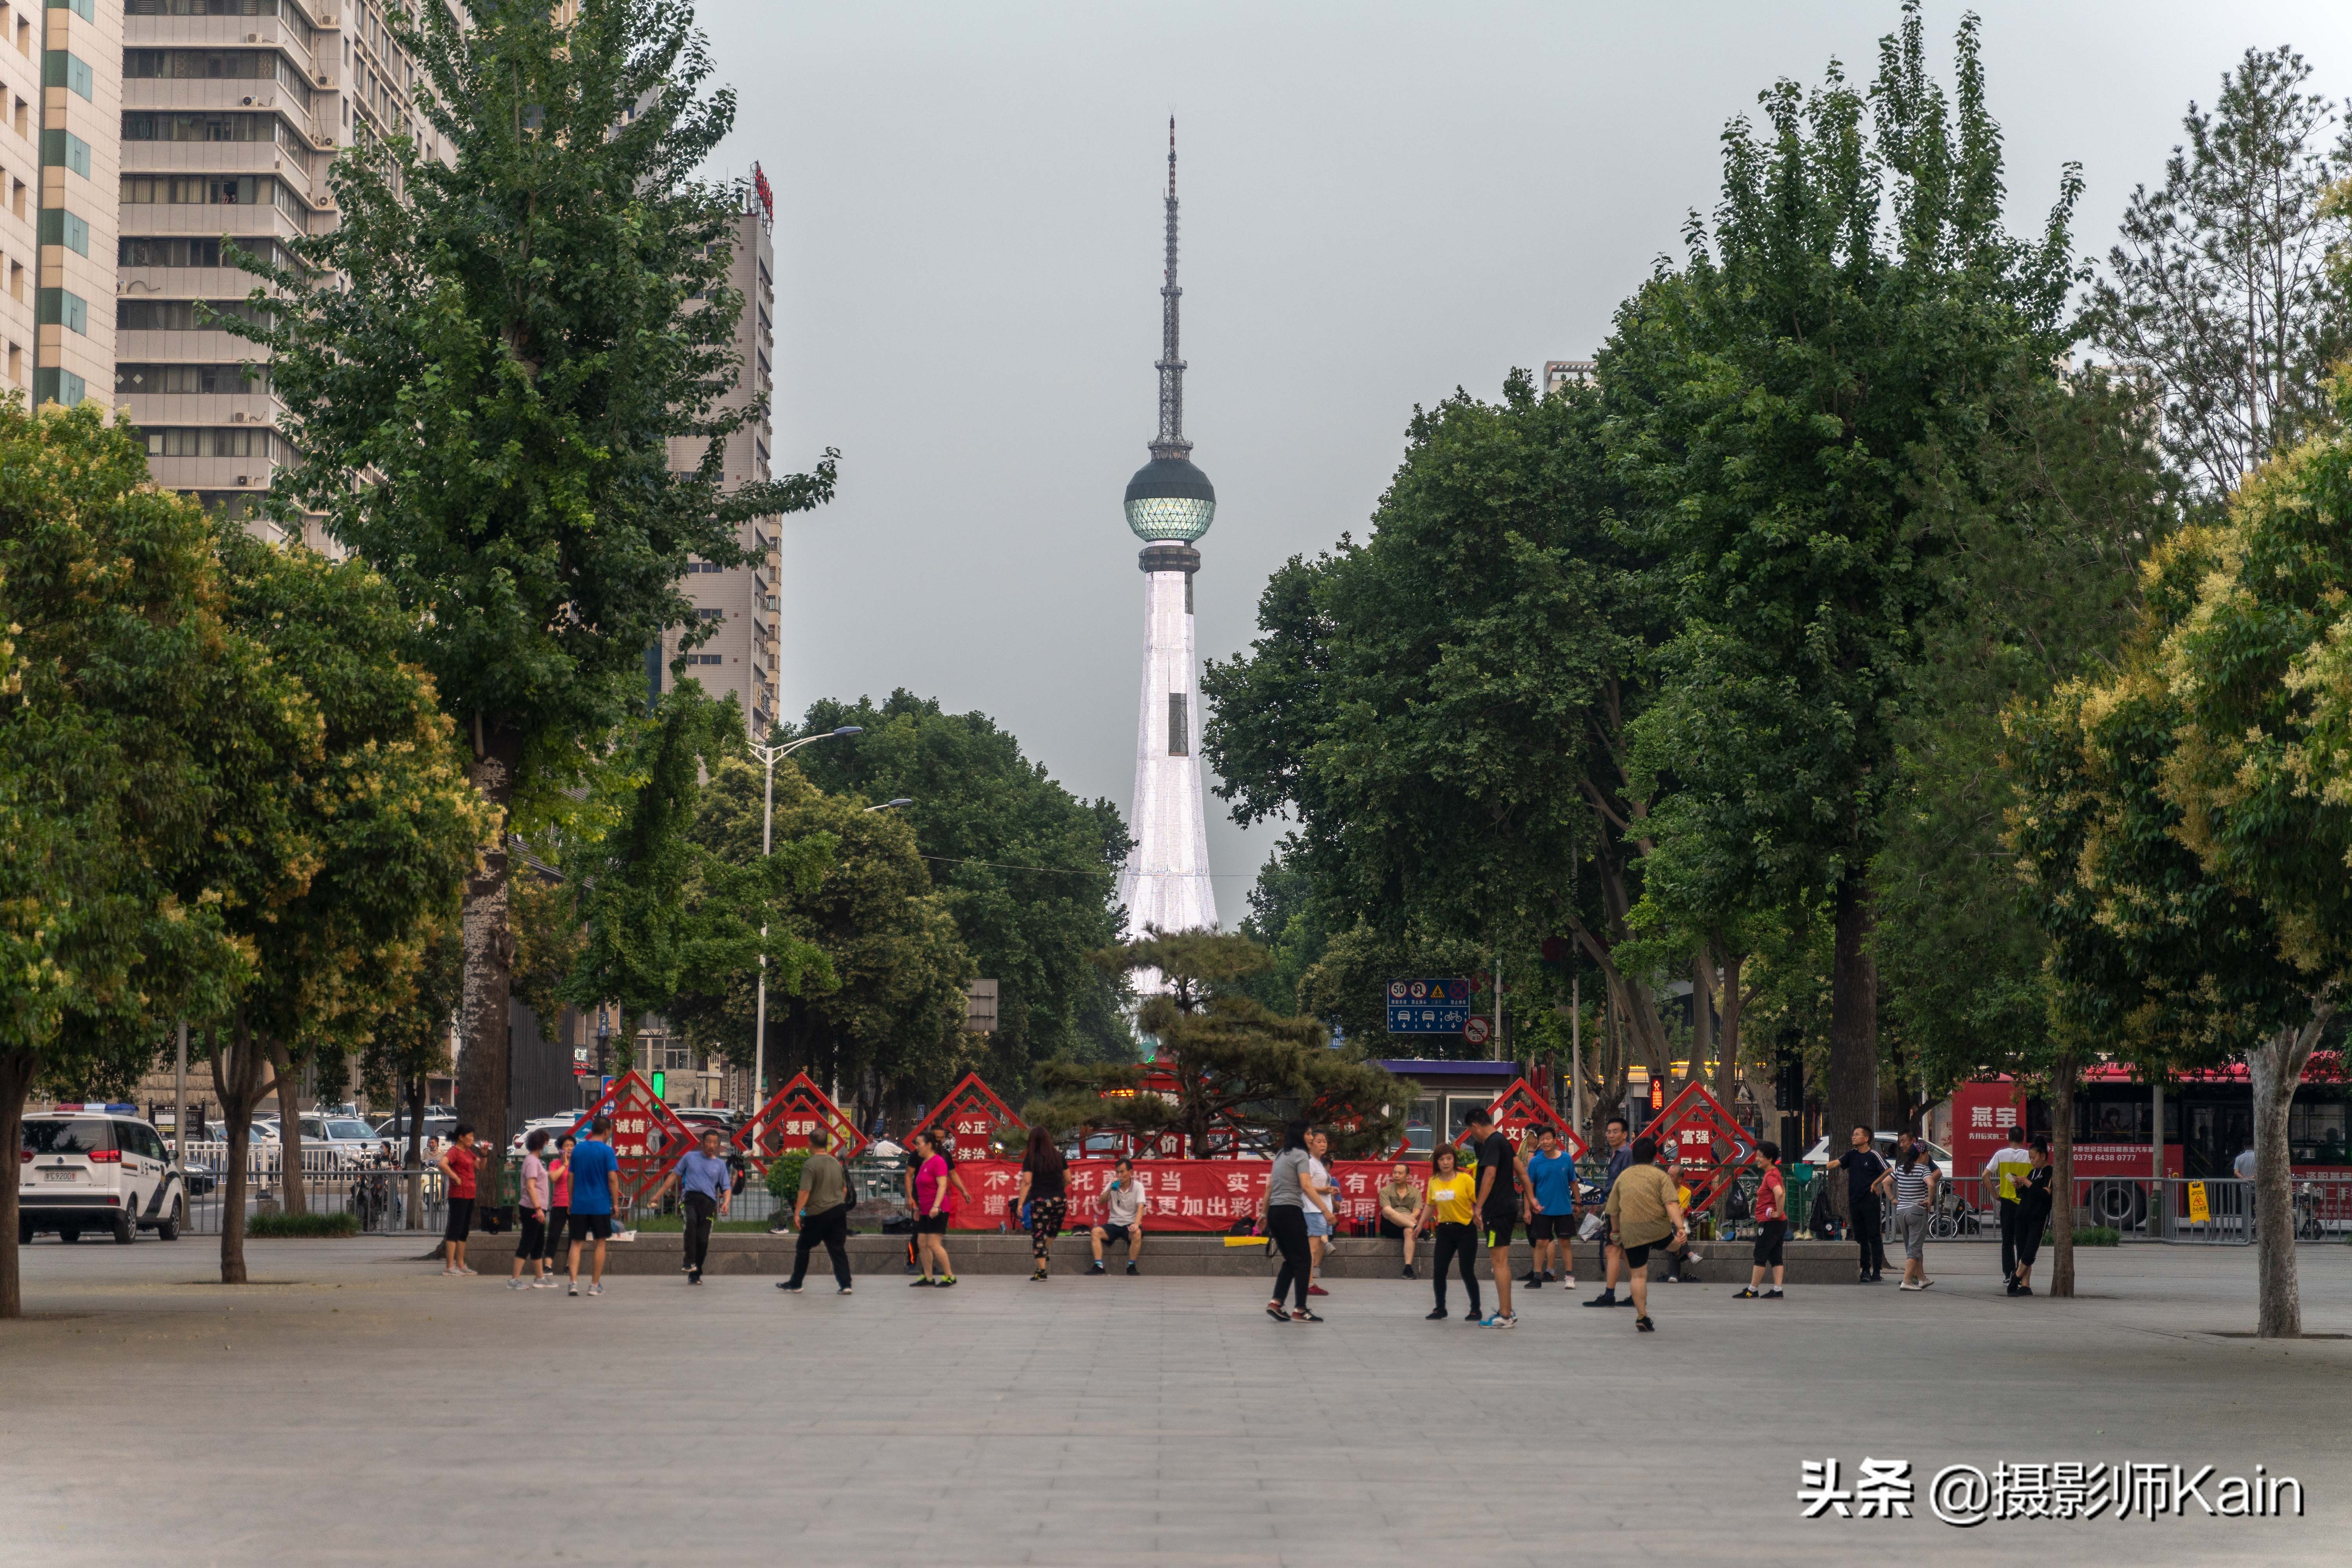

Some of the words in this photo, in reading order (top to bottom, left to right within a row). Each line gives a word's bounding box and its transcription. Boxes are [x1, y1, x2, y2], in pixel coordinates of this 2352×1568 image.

[1394, 985, 1404, 994] 50
[1972, 1107, 2016, 1127] 燕宝
[615, 1119, 644, 1134] 诚信
[786, 1121, 815, 1135] 爱国
[957, 1121, 987, 1134] 公正
[1681, 1130, 1710, 1144] 富强
[615, 1143, 644, 1157] 友善
[958, 1148, 986, 1160] 法治
[1681, 1158, 1708, 1172] 民主
